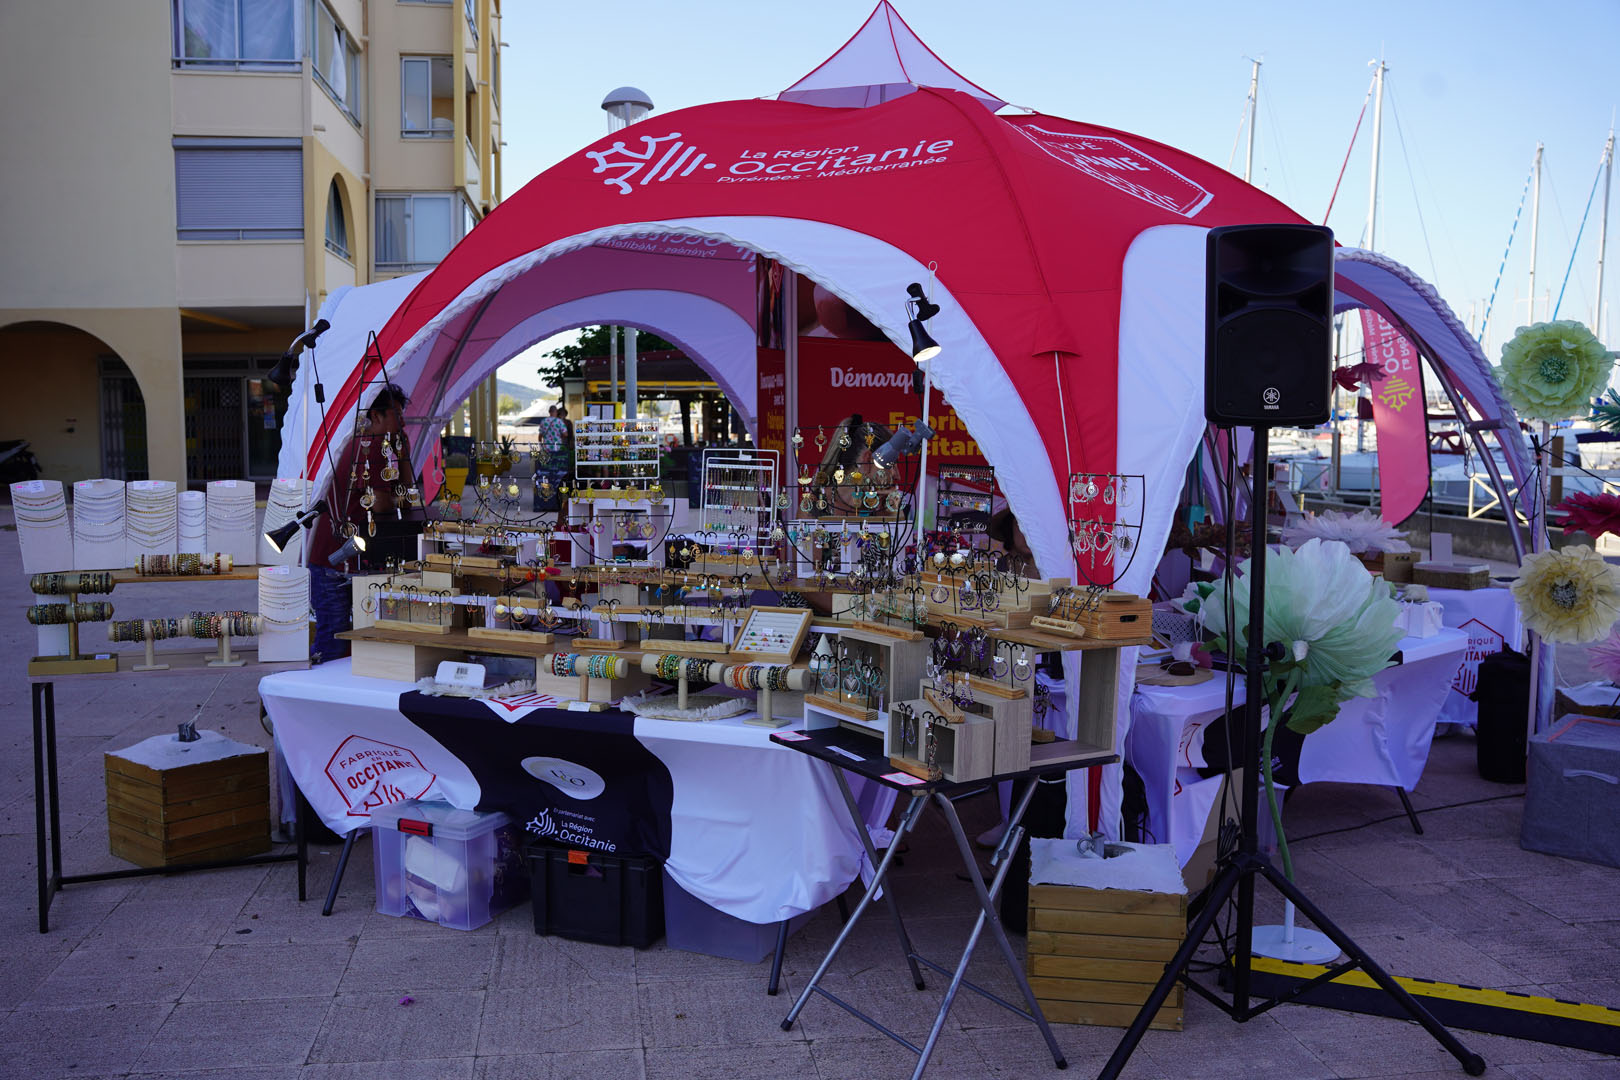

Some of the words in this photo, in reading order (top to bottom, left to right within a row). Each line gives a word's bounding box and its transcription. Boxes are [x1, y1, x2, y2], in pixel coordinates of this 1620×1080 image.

[729, 139, 954, 175] Occitanie
[740, 149, 767, 159] La
[773, 145, 859, 159] Région
[717, 175, 801, 183] Pyrénées
[817, 156, 947, 178] Méditerranée
[829, 366, 934, 394] Démarq
[561, 820, 568, 828] La
[568, 822, 593, 834] Région
[559, 829, 617, 853] Occitanie
